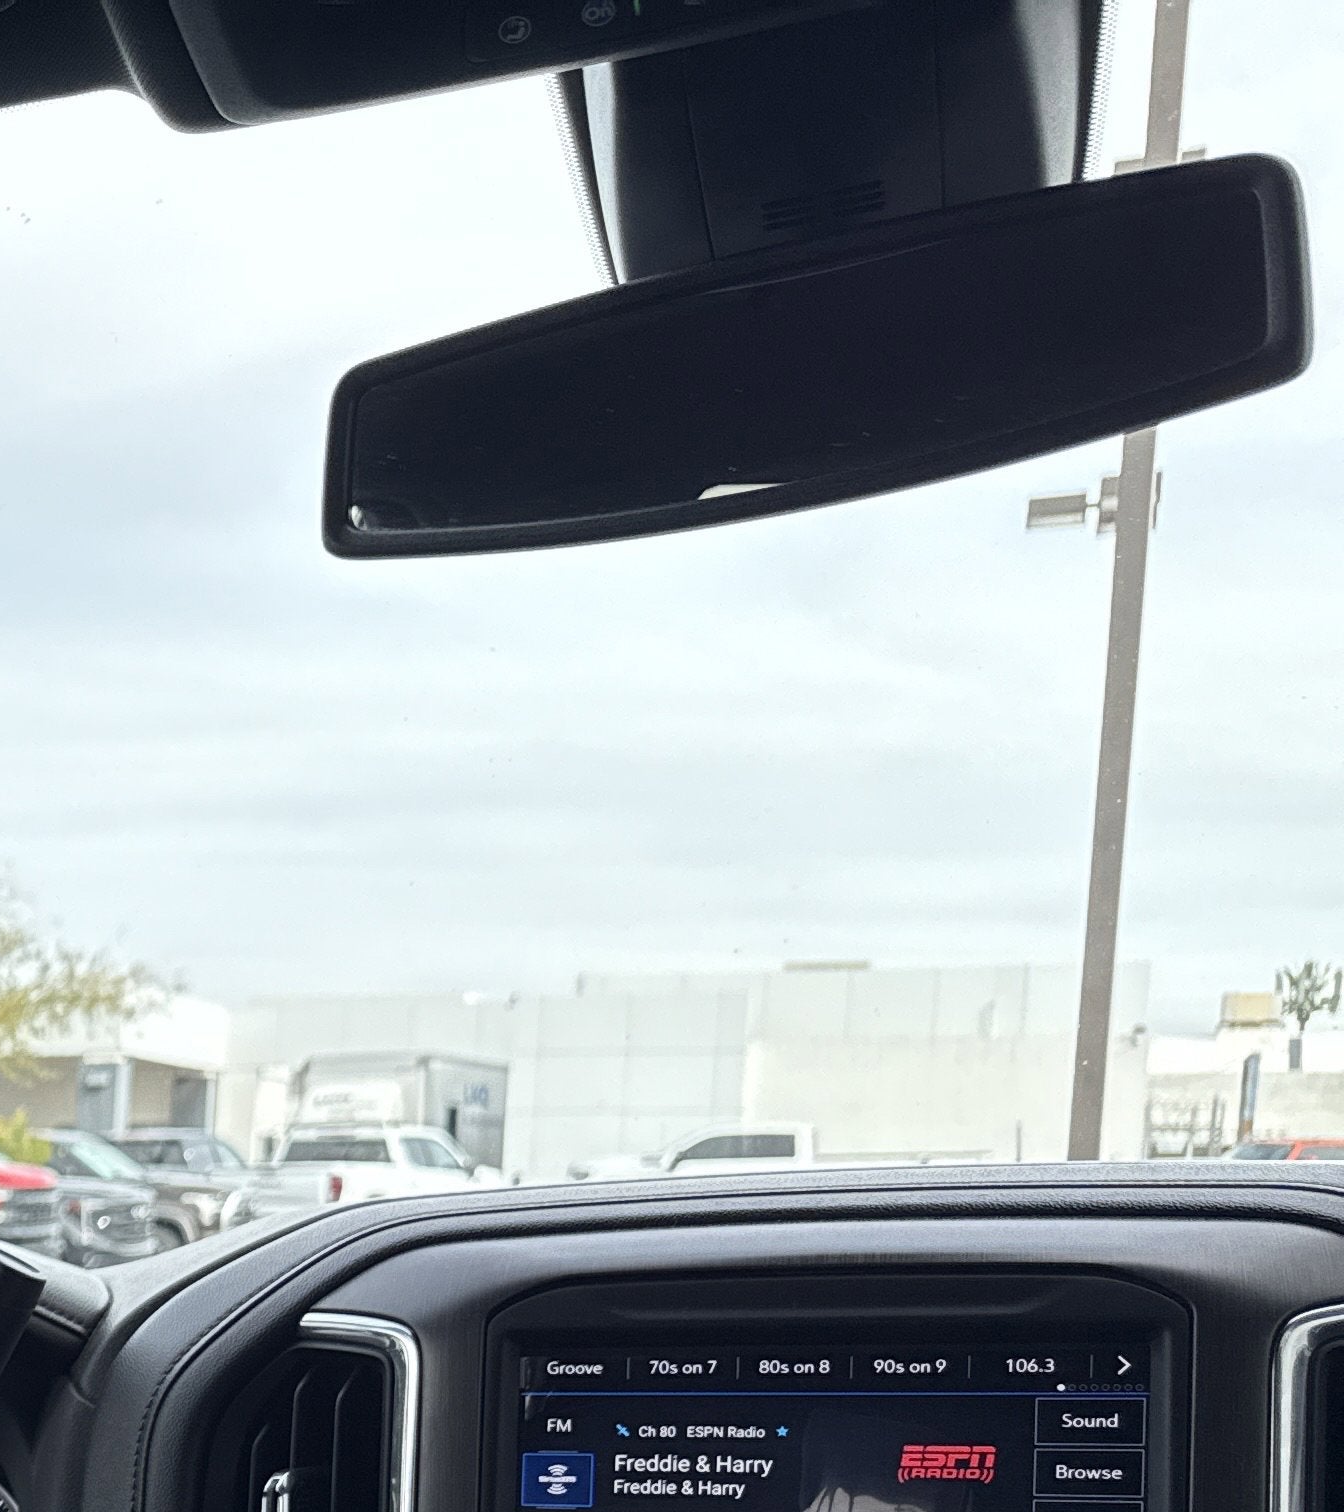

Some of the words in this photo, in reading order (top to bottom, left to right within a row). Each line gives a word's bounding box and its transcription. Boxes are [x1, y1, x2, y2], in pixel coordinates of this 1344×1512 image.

[546, 1361, 603, 1375] Groove
[649, 1360, 678, 1375] 70s
[682, 1363, 702, 1375] on
[708, 1360, 717, 1374] 7
[759, 1360, 789, 1374] 80s
[794, 1363, 814, 1374] on
[818, 1360, 830, 1374] 8
[873, 1360, 905, 1374] 90s
[909, 1363, 930, 1374] on
[935, 1360, 947, 1374] 9
[1005, 1359, 1055, 1373] 106.3
[546, 1418, 572, 1433] FM
[1061, 1413, 1119, 1428] Sound
[638, 1425, 657, 1438] Ch
[659, 1426, 677, 1438] 80
[686, 1425, 724, 1438] ESPN
[727, 1426, 766, 1438] Radio
[900, 1445, 997, 1468] ESPN
[614, 1454, 690, 1473] Freddie
[695, 1455, 711, 1473] &
[716, 1455, 773, 1477] Harry
[1055, 1464, 1123, 1480] Browse
[613, 1479, 677, 1495] Freddie
[681, 1480, 694, 1495] &
[698, 1480, 745, 1499] Harry
